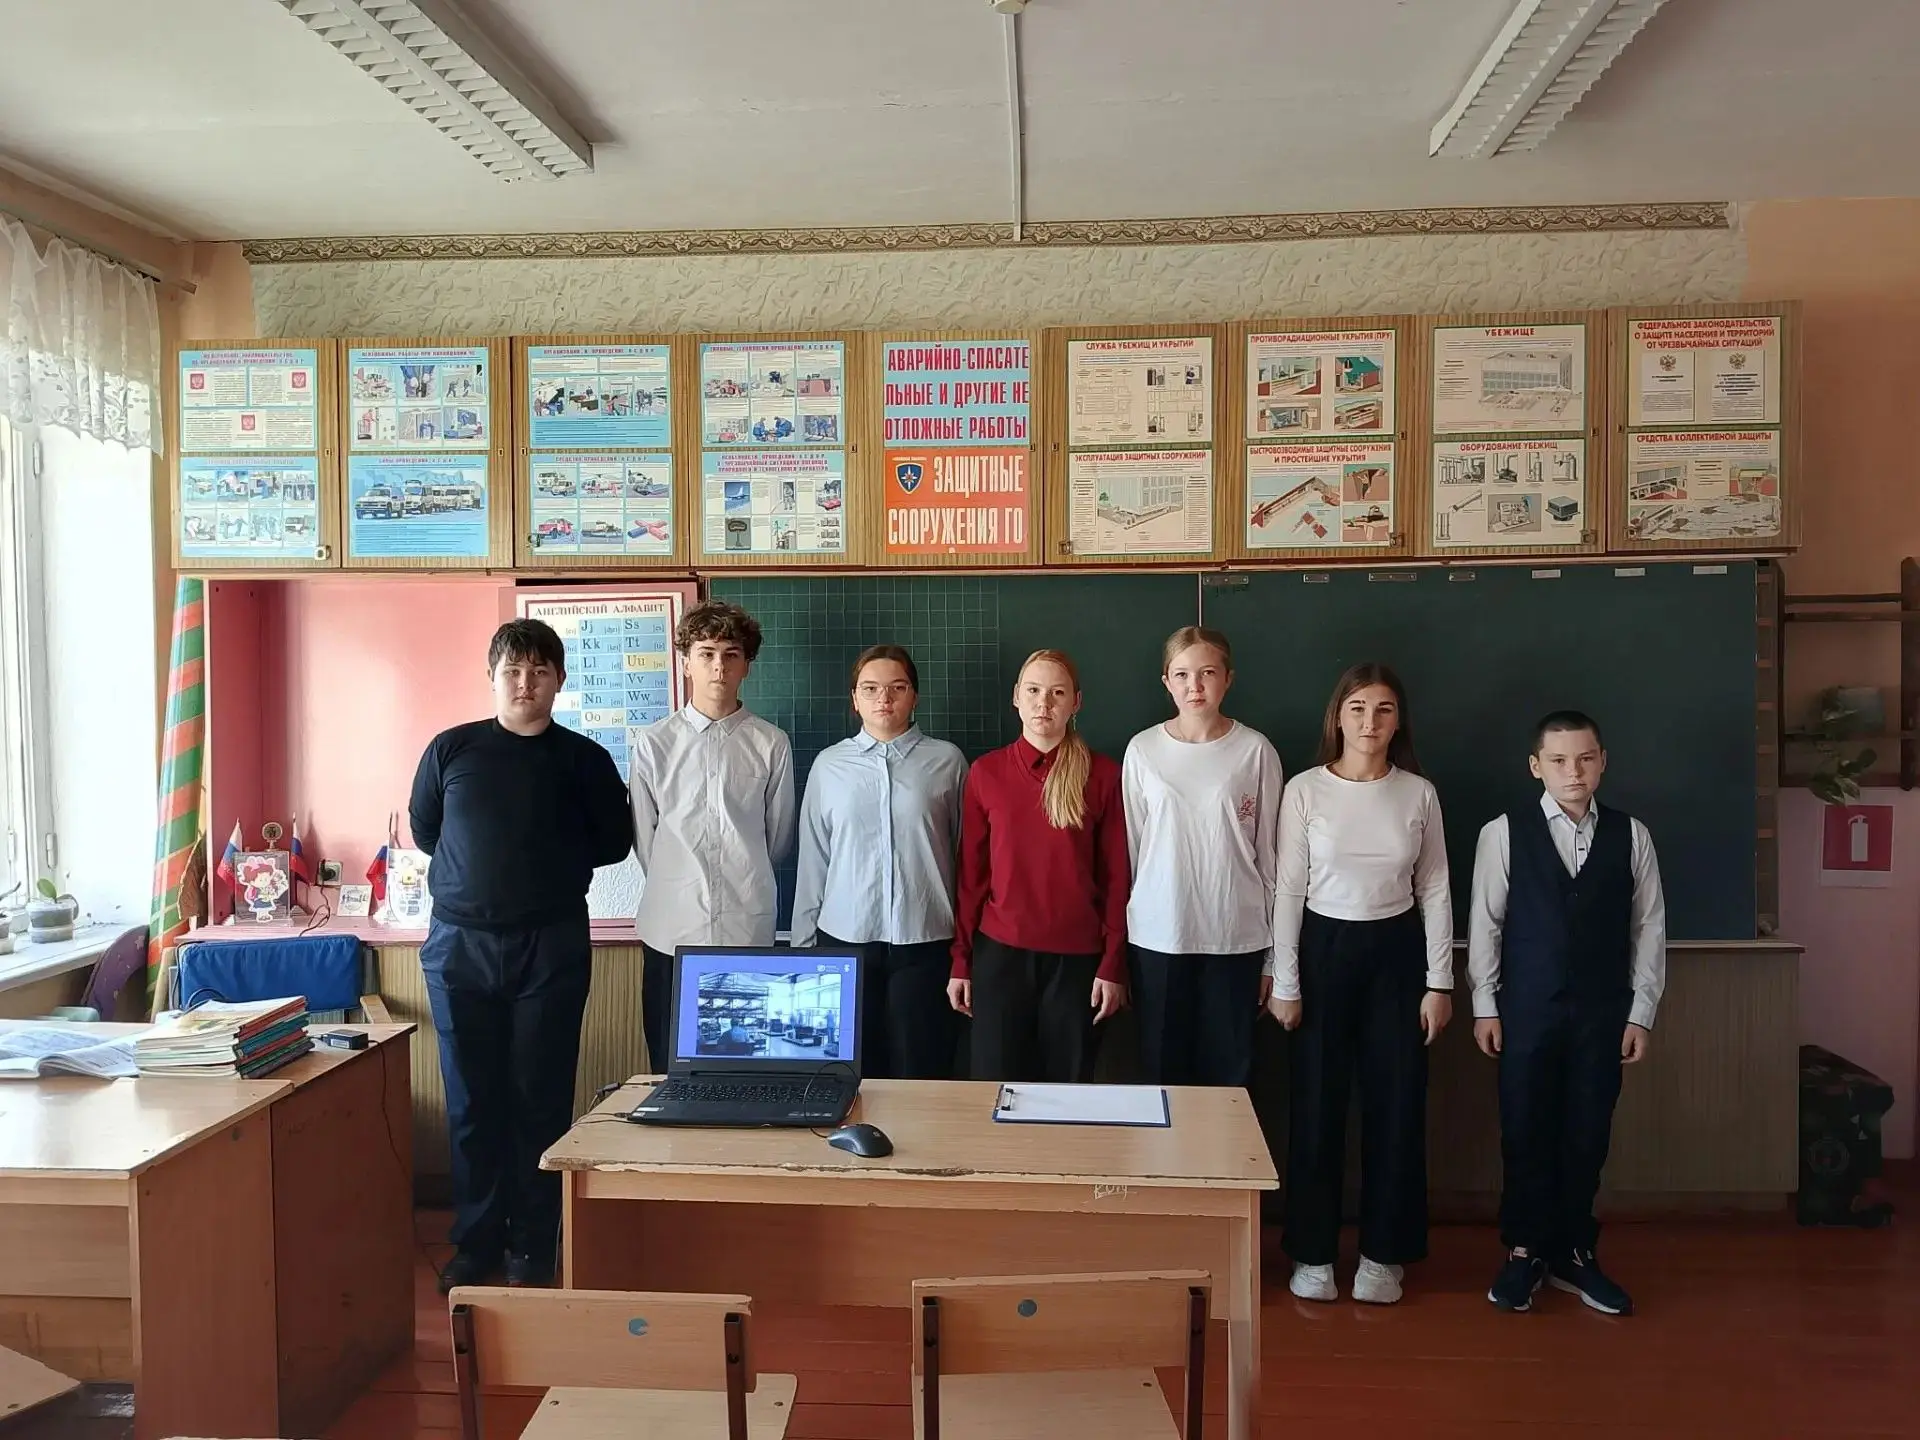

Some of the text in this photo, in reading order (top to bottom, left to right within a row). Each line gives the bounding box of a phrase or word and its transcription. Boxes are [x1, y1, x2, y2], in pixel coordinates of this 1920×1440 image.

[1637, 319, 1772, 330] ФЕДЕРАЛЬНОЕ ЗАКОНОДАТЕЛЬСТВО
[1342, 332, 1373, 341] УКРЫТИЯ
[1485, 328, 1535, 336] УБЕЖИЩЕ
[1642, 331, 1673, 340] ЗАЩИТЕ
[1674, 330, 1718, 338] НАСЕЛЕНИЯ
[1086, 342, 1117, 350] СЛУЖБА
[1119, 341, 1150, 350] УБЕЖИЩ
[1151, 341, 1158, 349] И
[1646, 341, 1656, 349] ОТ
[885, 381, 1029, 408] ЛЬНЫЕ И ДРУГИЕ НЕ
[884, 416, 1026, 440] ОТЛОЖНЫЕ РАБОТЫ
[1636, 434, 1673, 443] СРЕДСТВА
[1738, 432, 1772, 441] ЗАЩИТЫ
[1316, 445, 1349, 454] ЗАЩИТНЫЕ
[1350, 444, 1391, 453] СООРУЖЕНИЯ
[1460, 442, 1558, 451] ОБОРУДОВАНИЕ УБЕЖИЩ
[1075, 453, 1124, 462] ЭКСПЛУАТАЦИЯ
[1124, 452, 1161, 461] ЗАЩИТНЫХ
[1332, 454, 1366, 463] УКРЫТИЯ
[933, 455, 1024, 498] ЗАЩИТНЫЕ
[888, 507, 1023, 545] СООРУЖЕНИЯ ГО
[535, 603, 665, 616] АНГЛИЙСКИЙ АЛФАВИТ
[626, 636, 640, 648] Tt
[627, 654, 645, 666] Uu
[583, 675, 607, 686] Mm
[627, 673, 644, 684] Vv
[584, 693, 602, 704] Nn
[627, 690, 650, 702] Ww
